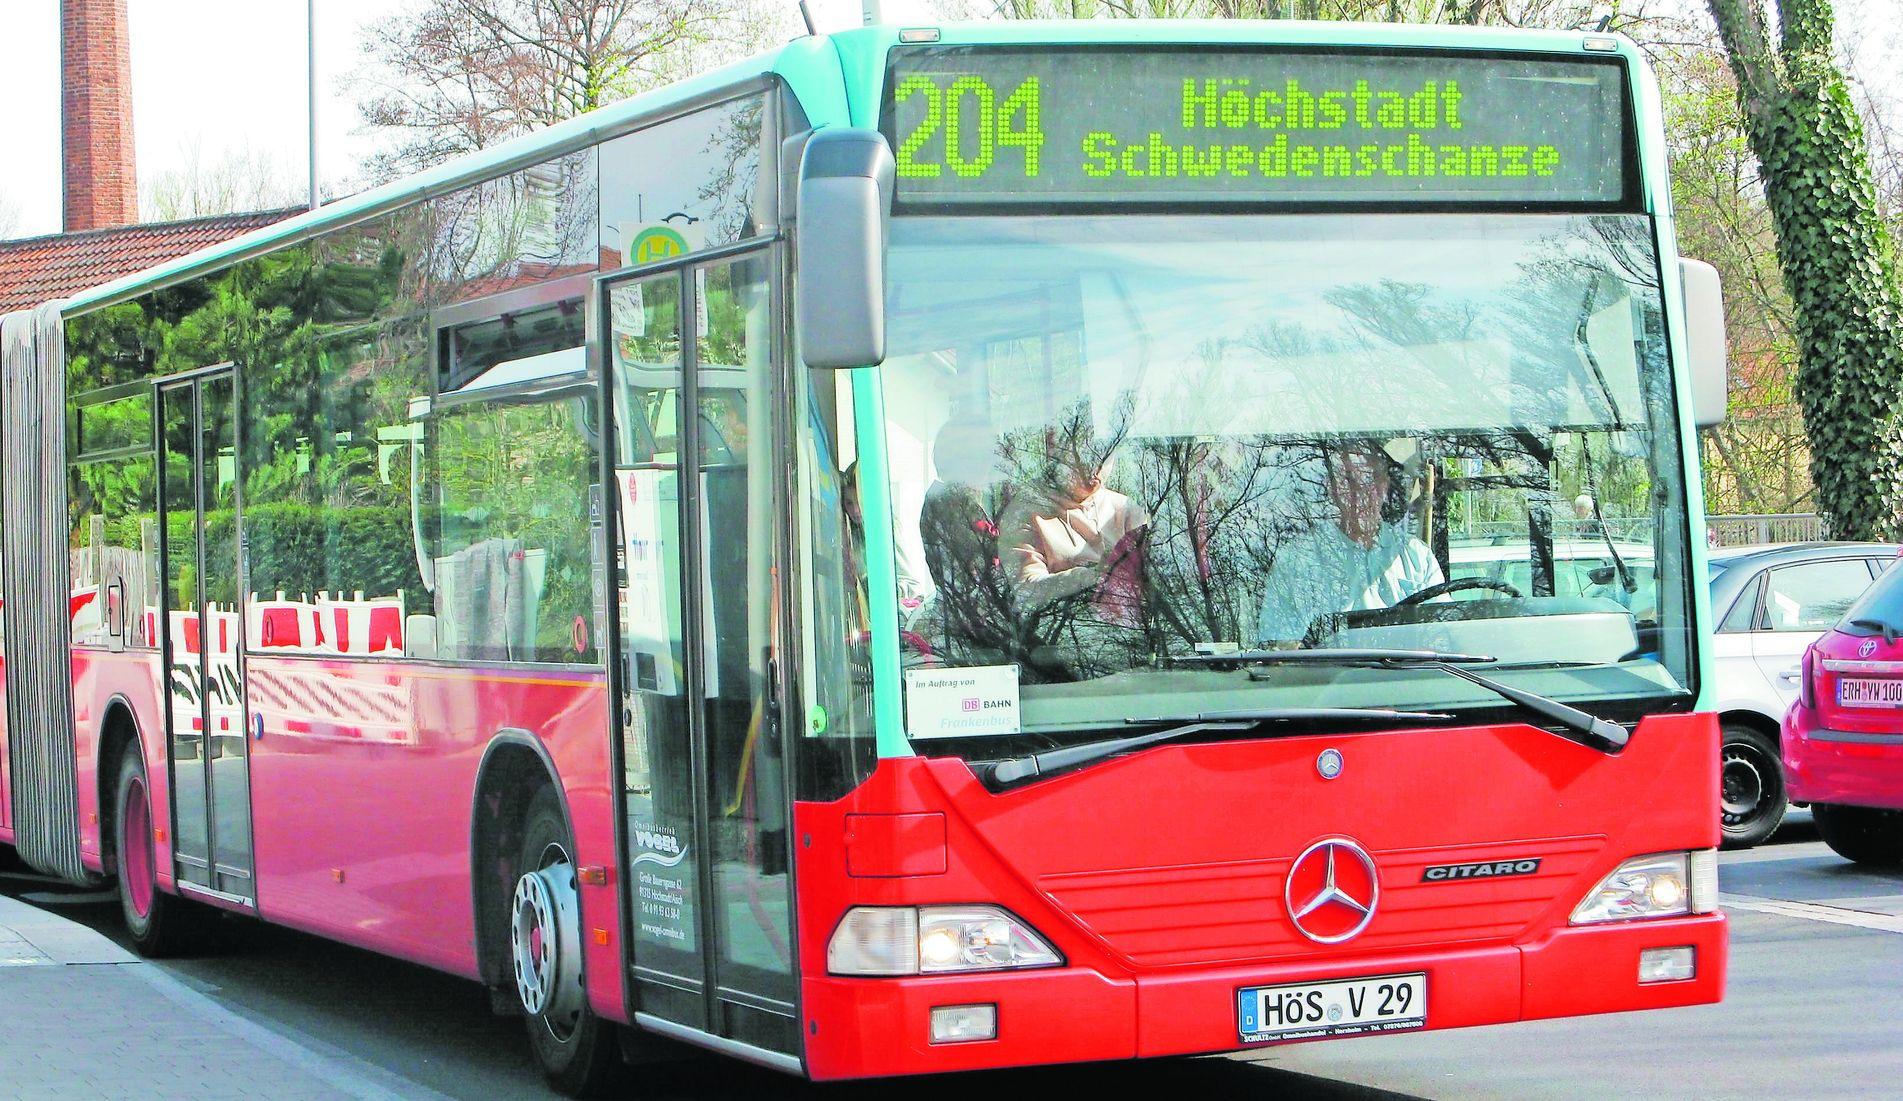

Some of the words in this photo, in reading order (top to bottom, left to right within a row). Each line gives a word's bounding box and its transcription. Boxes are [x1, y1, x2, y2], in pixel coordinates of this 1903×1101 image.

[1181, 77, 1464, 130] Höchstadt
[895, 76, 1044, 178] 204
[1083, 131, 1560, 178] Schwedenschanze
[928, 680, 958, 688] Auftrag
[1842, 681, 1861, 700] ERH
[1882, 682, 1903, 701] 100
[963, 699, 979, 710] DB
[983, 699, 1012, 709] BAHN
[940, 715, 1011, 729] Frankenbus
[635, 830, 680, 854] VOGEL
[1426, 860, 1537, 880] CITARO
[1264, 990, 1324, 1026] HöS
[1348, 986, 1366, 1018] V
[1377, 982, 1413, 1016] 29
[1246, 1015, 1254, 1026] D
